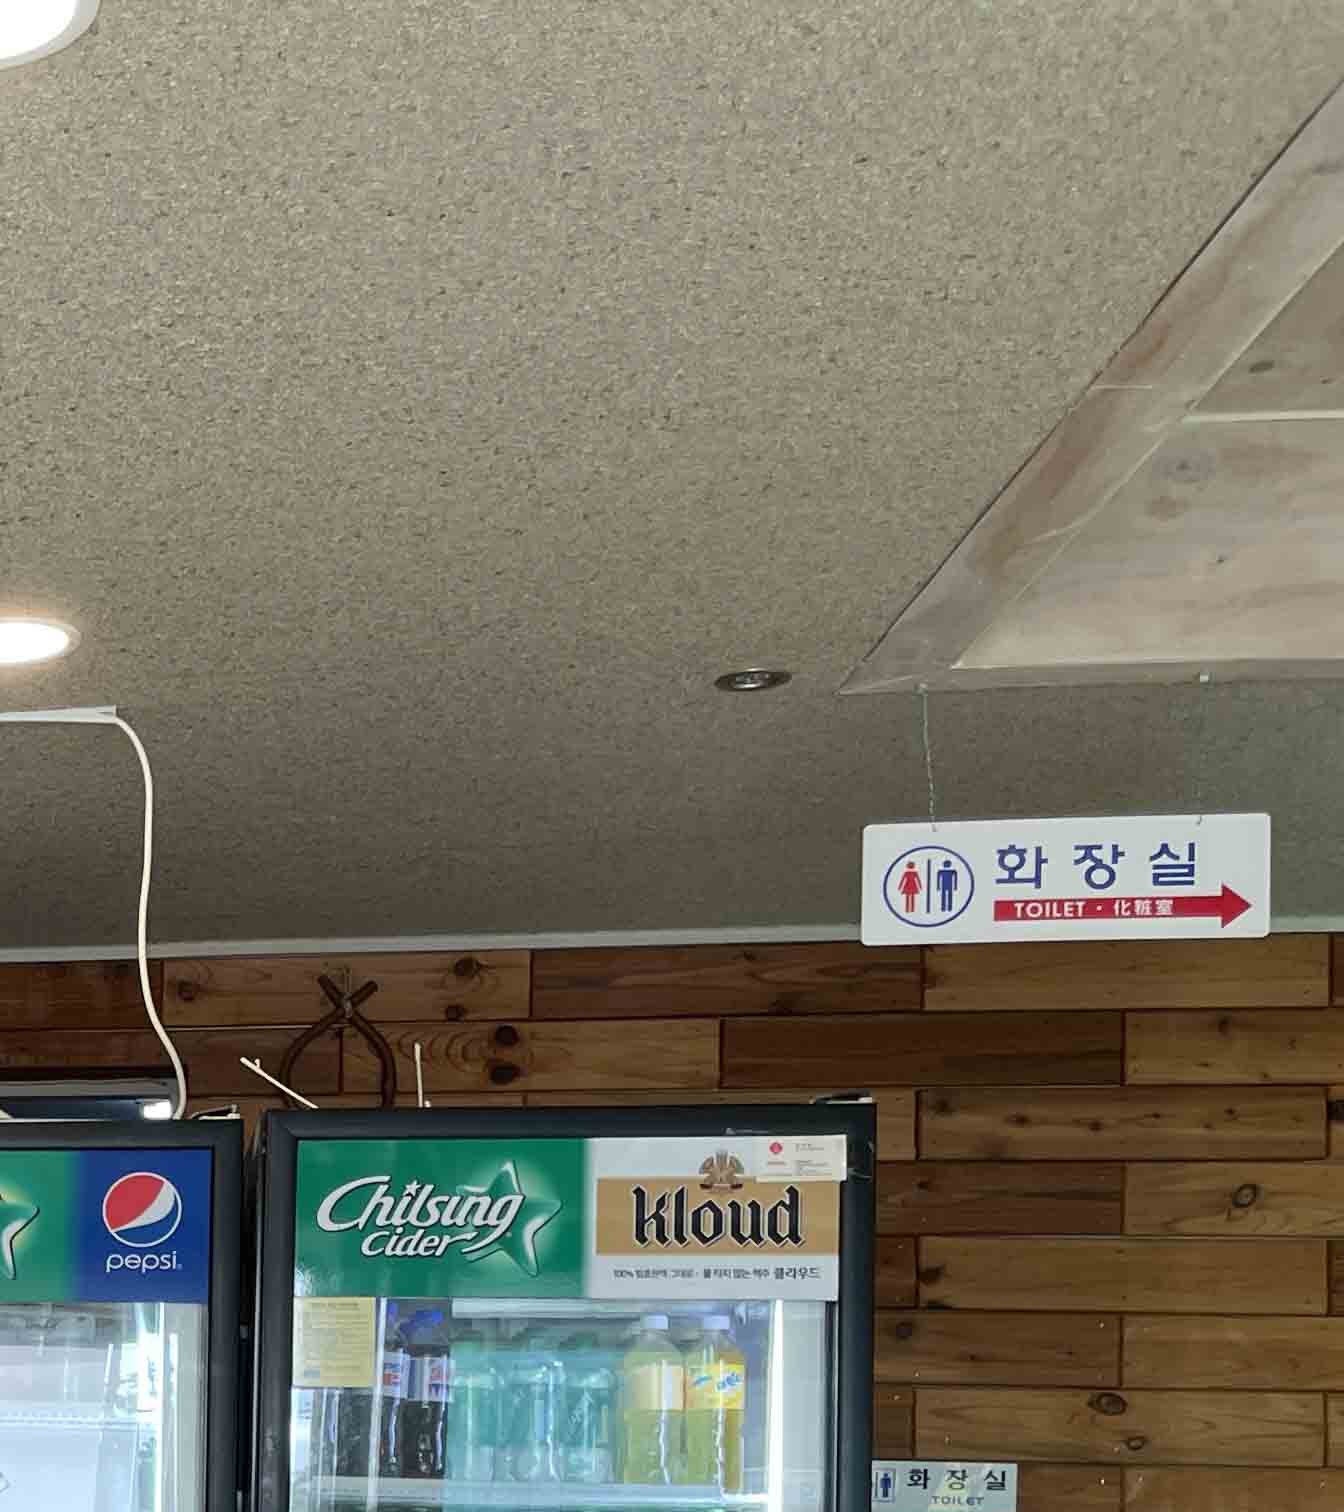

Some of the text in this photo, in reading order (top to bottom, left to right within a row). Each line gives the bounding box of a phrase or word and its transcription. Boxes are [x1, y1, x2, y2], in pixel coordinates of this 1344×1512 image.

[1014, 901, 1086, 919] TOILET
[316, 1174, 525, 1253] Chilsung
[361, 1229, 462, 1259] Cider
[105, 1250, 178, 1274] pepsi
[931, 1496, 985, 1506] TOILET
